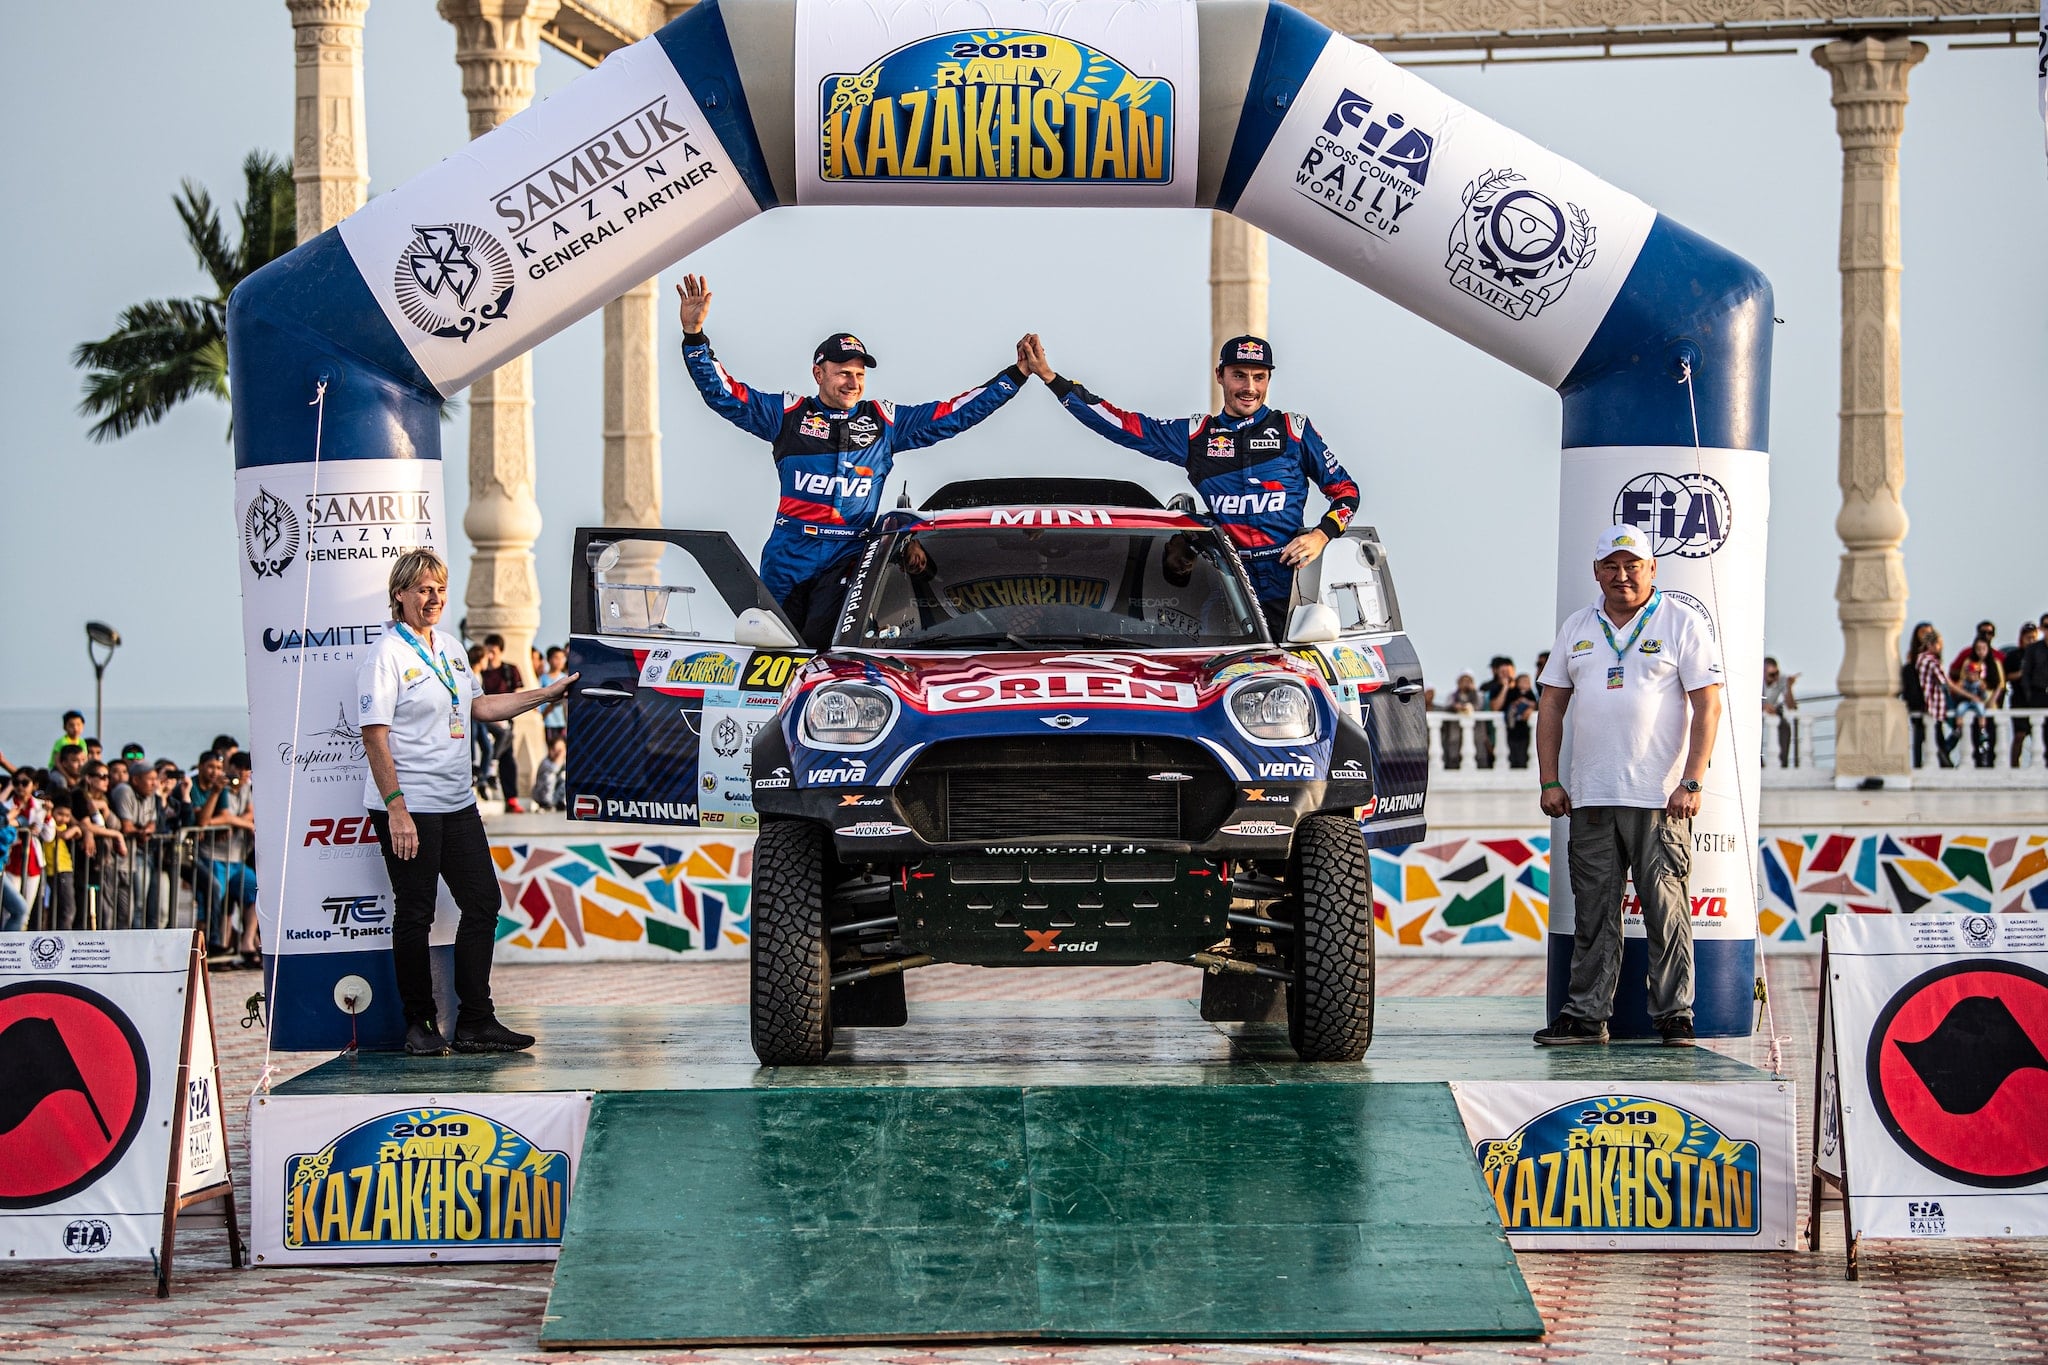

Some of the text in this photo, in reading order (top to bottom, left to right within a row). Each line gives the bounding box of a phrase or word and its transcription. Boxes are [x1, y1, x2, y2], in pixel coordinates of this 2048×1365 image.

[952, 43, 1047, 59] 2019
[937, 63, 1061, 88] RALLY
[831, 86, 1164, 180] KAZAKHSTAN
[494, 101, 686, 234] SAMRUK
[1315, 135, 1421, 200] CROSS COUNTRY
[1300, 147, 1414, 222] RALLY
[1295, 171, 1401, 237] WORLD CUP
[529, 161, 718, 281] GENERAL PARTNER
[1457, 275, 1521, 316] AMFK
[801, 425, 829, 440] Red Bull
[1208, 448, 1235, 457] Red Bull
[795, 470, 871, 498] verva
[306, 495, 431, 524] SAMRUK
[1210, 491, 1286, 515] verva
[990, 509, 1112, 526] MINI
[306, 547, 377, 562] GENERAL
[841, 538, 880, 634] www.x-raid.de
[282, 624, 383, 647] AMITE
[281, 652, 354, 663] AMITECH
[669, 661, 736, 685] KAZAKHSTAN
[942, 676, 1179, 703] ORLEN
[278, 743, 343, 772] Caspian
[310, 775, 342, 783] GRAND
[807, 766, 867, 784] verva
[1258, 763, 1315, 778] verva
[757, 779, 788, 788] ORLEN
[607, 800, 699, 821] PLATINUM
[1378, 792, 1424, 815] PLATINUM
[701, 813, 725, 822] RED
[855, 826, 891, 836] WORKS
[1239, 825, 1276, 834] WORKS
[985, 844, 1147, 855] www.x-raid.de
[1694, 833, 1736, 853] YSTEM
[1581, 1110, 1657, 1125] 2019
[393, 1123, 468, 1138] 2019
[1569, 1129, 1669, 1149] RALLY
[380, 1141, 480, 1163] RALLY
[1485, 1147, 1752, 1229] KAZAKHSTAN
[293, 1159, 561, 1243] KAZAKHSTAN
[1910, 1221, 1945, 1229] RALLY
